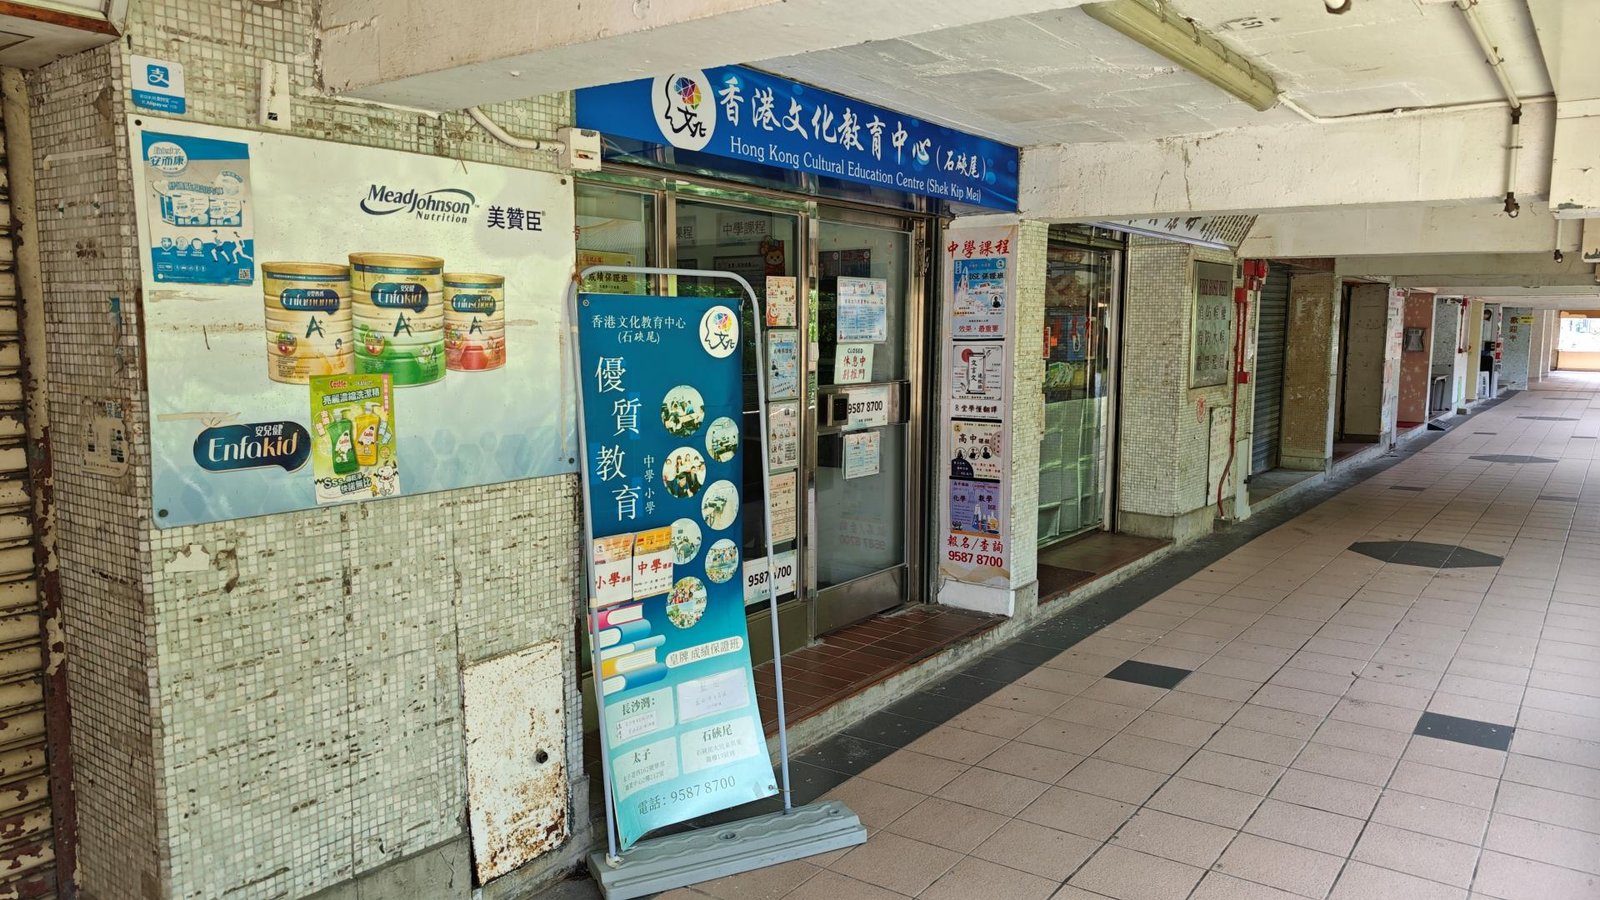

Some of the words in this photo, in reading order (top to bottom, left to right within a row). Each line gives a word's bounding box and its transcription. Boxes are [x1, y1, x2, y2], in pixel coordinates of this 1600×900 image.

[718, 76, 931, 164] 香港文化教育中心
[731, 136, 765, 163] Hong
[769, 145, 800, 169] Kong
[803, 152, 845, 175] Cultural
[848, 162, 894, 184] Education
[896, 172, 925, 191] Centre
[927, 178, 949, 196] (Shek
[951, 183, 964, 200] Kip
[416, 211, 468, 224] Nutrition
[723, 220, 766, 236] 中學課程
[947, 239, 1010, 259] 中學課程
[377, 289, 422, 304] Enfakid
[592, 314, 687, 330] 香港文化教育中心
[617, 330, 661, 345] (石硤尾)
[843, 355, 866, 367] 休息中
[847, 402, 865, 415] 9587
[866, 400, 883, 412] 8700
[255, 424, 284, 437] 安兒健
[208, 430, 299, 462] Enfakid
[947, 534, 1004, 554] 報名/查詢
[948, 551, 974, 564] 9587
[976, 554, 1003, 568] 8700
[748, 570, 769, 587] 9587
[632, 748, 652, 764] 太子
[670, 785, 701, 804] 9587
[704, 775, 737, 794] 8700
